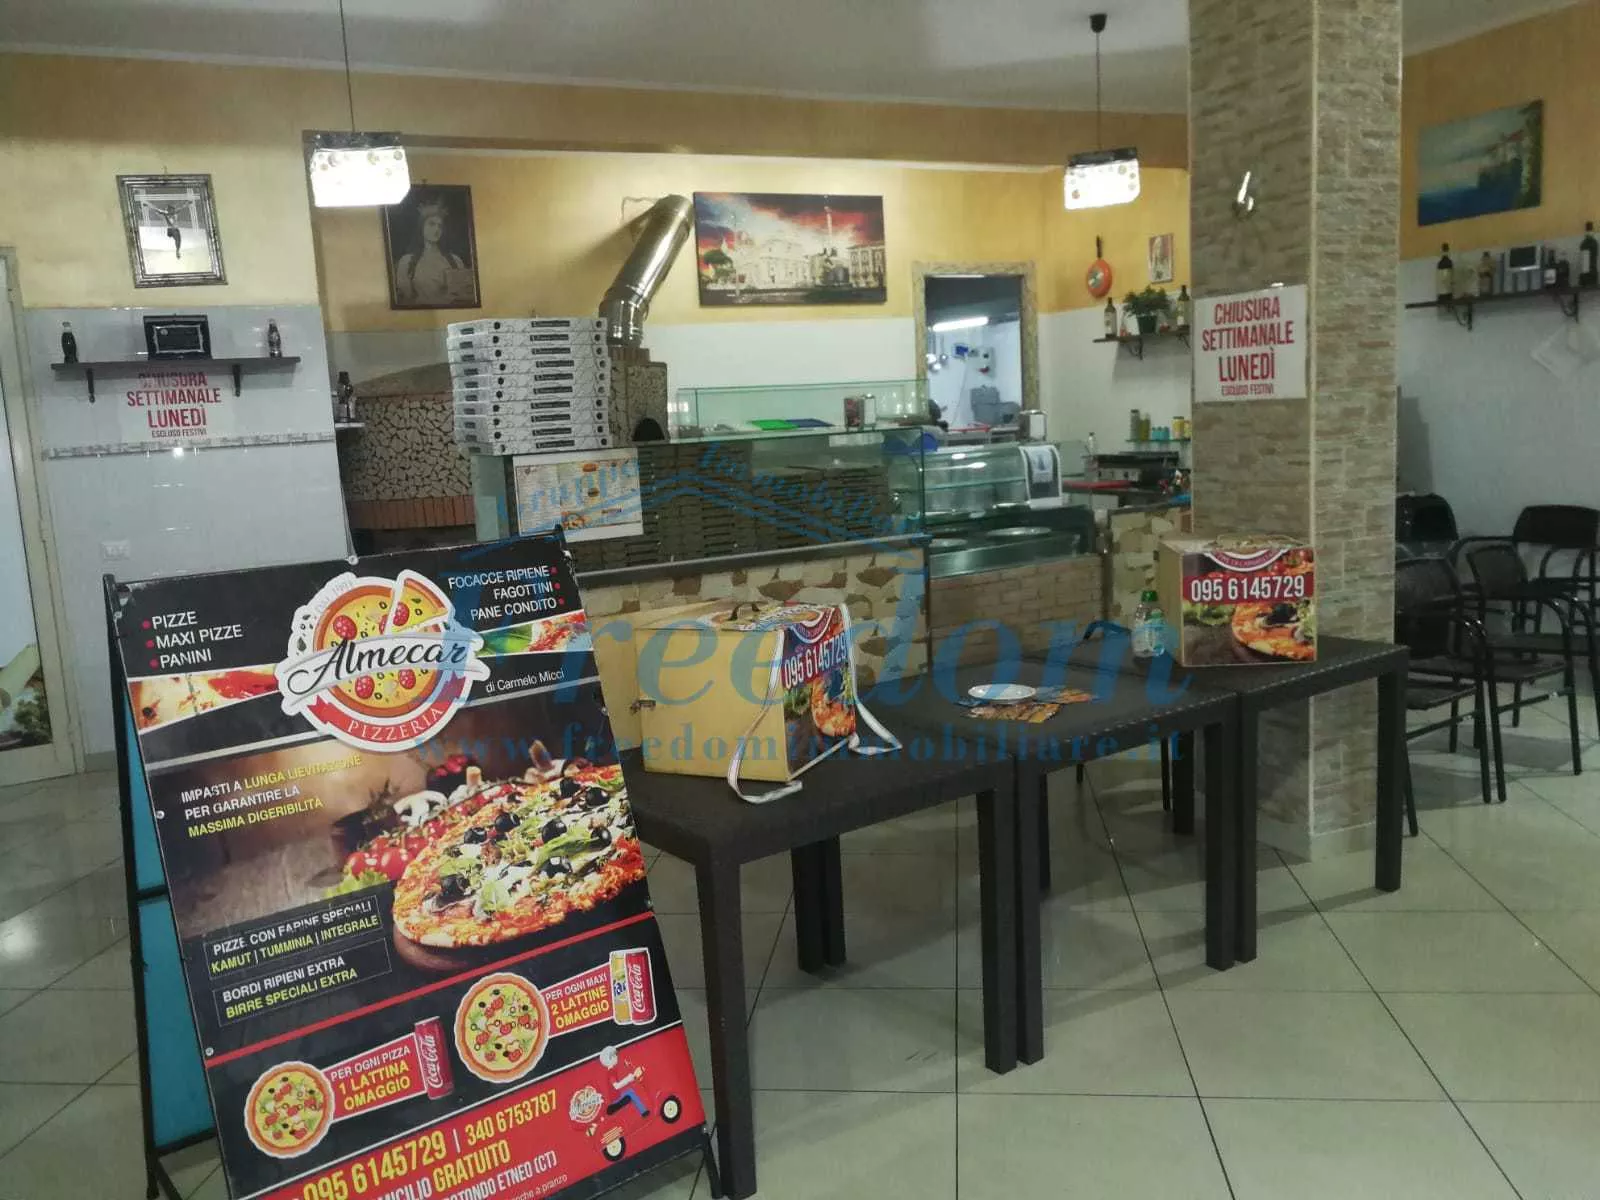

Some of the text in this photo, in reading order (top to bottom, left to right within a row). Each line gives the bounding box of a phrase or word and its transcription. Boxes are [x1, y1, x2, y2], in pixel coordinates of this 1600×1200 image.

[1214, 296, 1281, 326] CHIUSURA
[1202, 321, 1295, 351] SETTIMANALE
[1218, 347, 1275, 382] LUNEDÌ
[126, 388, 222, 407] SETTIMANALE
[147, 404, 208, 428] LUNEDÌ
[448, 565, 550, 590] FOCACCE RIPIENE
[493, 581, 553, 600] FAGOTTINI
[1191, 575, 1305, 602] 095 6145729
[151, 610, 198, 629] PIZZE
[470, 596, 557, 621] PANE CONDITO
[156, 623, 244, 649] MAXI PIZZE
[159, 648, 213, 669] PANINI
[287, 638, 468, 696] Almecar
[784, 631, 848, 690] 095 6145729
[485, 667, 565, 694] di Carmelo Micci
[347, 707, 445, 741] PIZZERIA
[180, 782, 231, 803] IMPASTI
[233, 780, 242, 792] A
[244, 771, 286, 789] LUNGA
[185, 785, 300, 820] PER GARANTIRE LA
[188, 815, 246, 838] MASSIMA
[213, 936, 247, 956] PIZZE
[250, 928, 276, 945] CON
[321, 900, 372, 924] SPECIALI
[211, 952, 252, 974] KAMUT
[260, 934, 314, 959] TUMMINIA
[320, 914, 379, 941] INTEGRALE
[222, 955, 346, 1003] BORDI RIPIENI EXTRA
[225, 967, 358, 1019] BIRRE SPECIALI EXTRA
[545, 973, 608, 1002] PER OGNI MAXI
[551, 986, 609, 1016] 2 LATTINE
[554, 999, 610, 1030] OMAGGIO
[330, 1045, 410, 1082] PER OGNI PIZZA
[339, 1062, 410, 1095] 1 LATTINA
[343, 1075, 411, 1111] OMAGGIO
[303, 1170, 349, 1200] 095
[352, 1130, 448, 1194] 6145729
[465, 1115, 494, 1146] 340
[496, 1089, 558, 1130] 6753787
[432, 1139, 512, 1193] GRATUITO
[497, 1161, 533, 1191] ETNEO
[535, 1150, 558, 1174] (CT)
